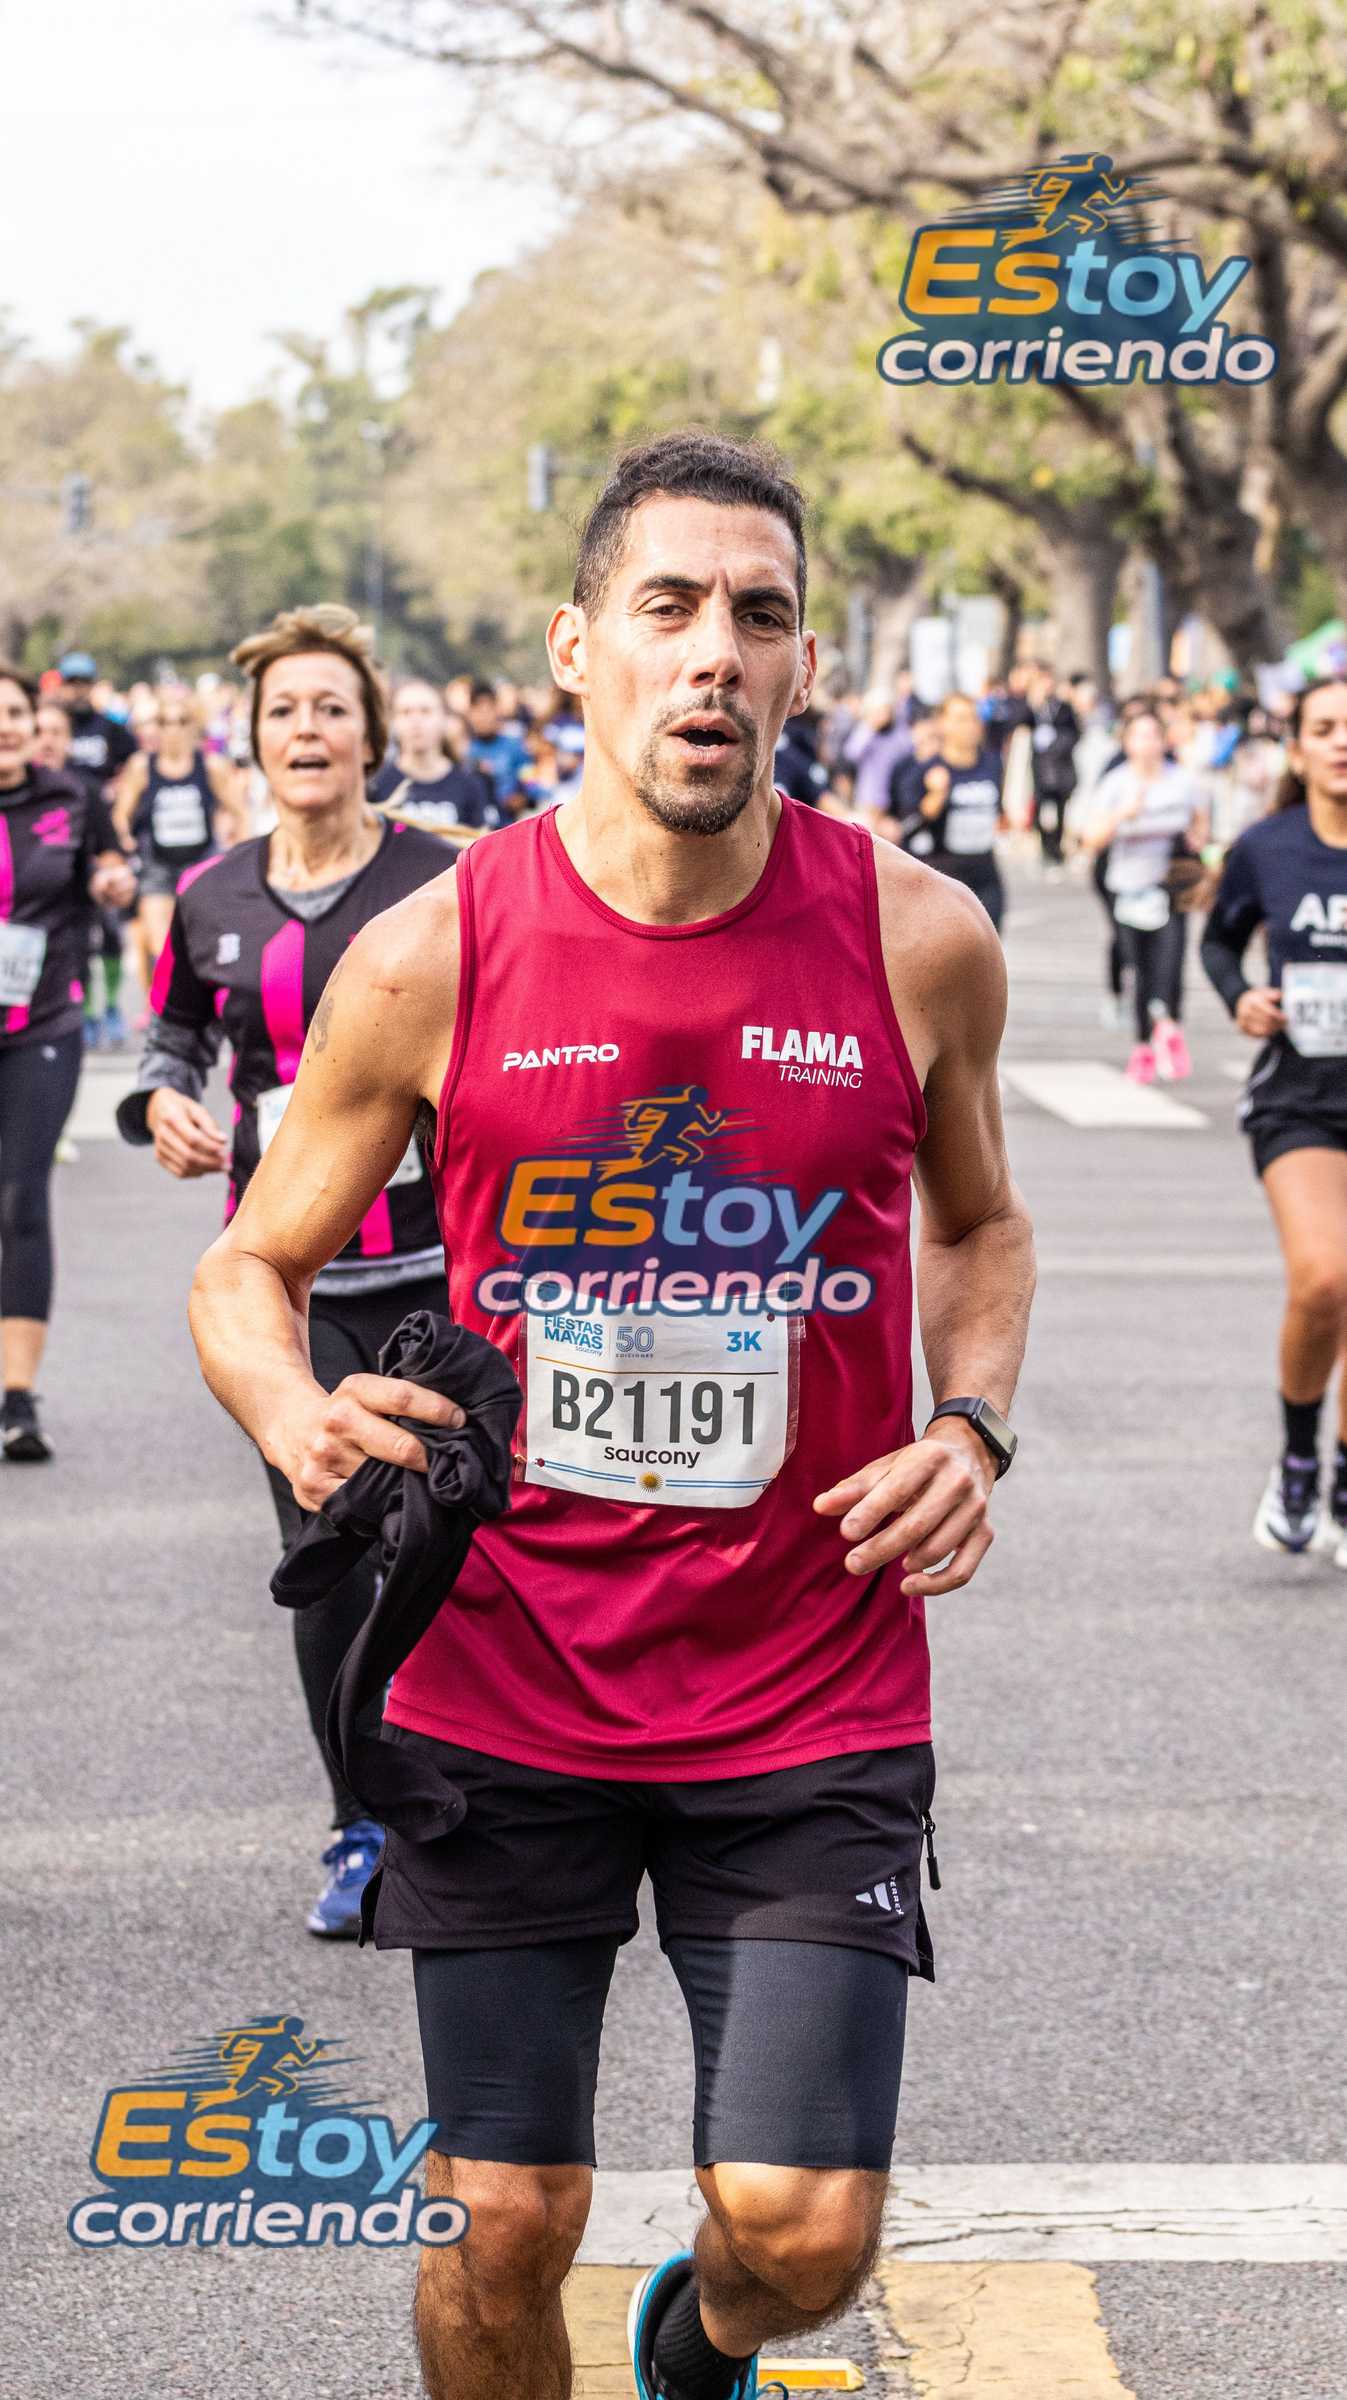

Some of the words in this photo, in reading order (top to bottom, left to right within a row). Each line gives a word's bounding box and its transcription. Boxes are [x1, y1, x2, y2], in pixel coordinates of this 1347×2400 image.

[502, 1043, 620, 1072] PANTRO
[741, 1025, 863, 1069] FLAMA
[778, 1064, 863, 1089] TRAINING
[544, 1313, 604, 1336] FIESTAS
[544, 1326, 603, 1350] MAYAS
[615, 1326, 655, 1353] 50
[726, 1330, 763, 1352] 3K
[552, 1369, 755, 1445] B21191
[604, 1446, 700, 1469] saucony
